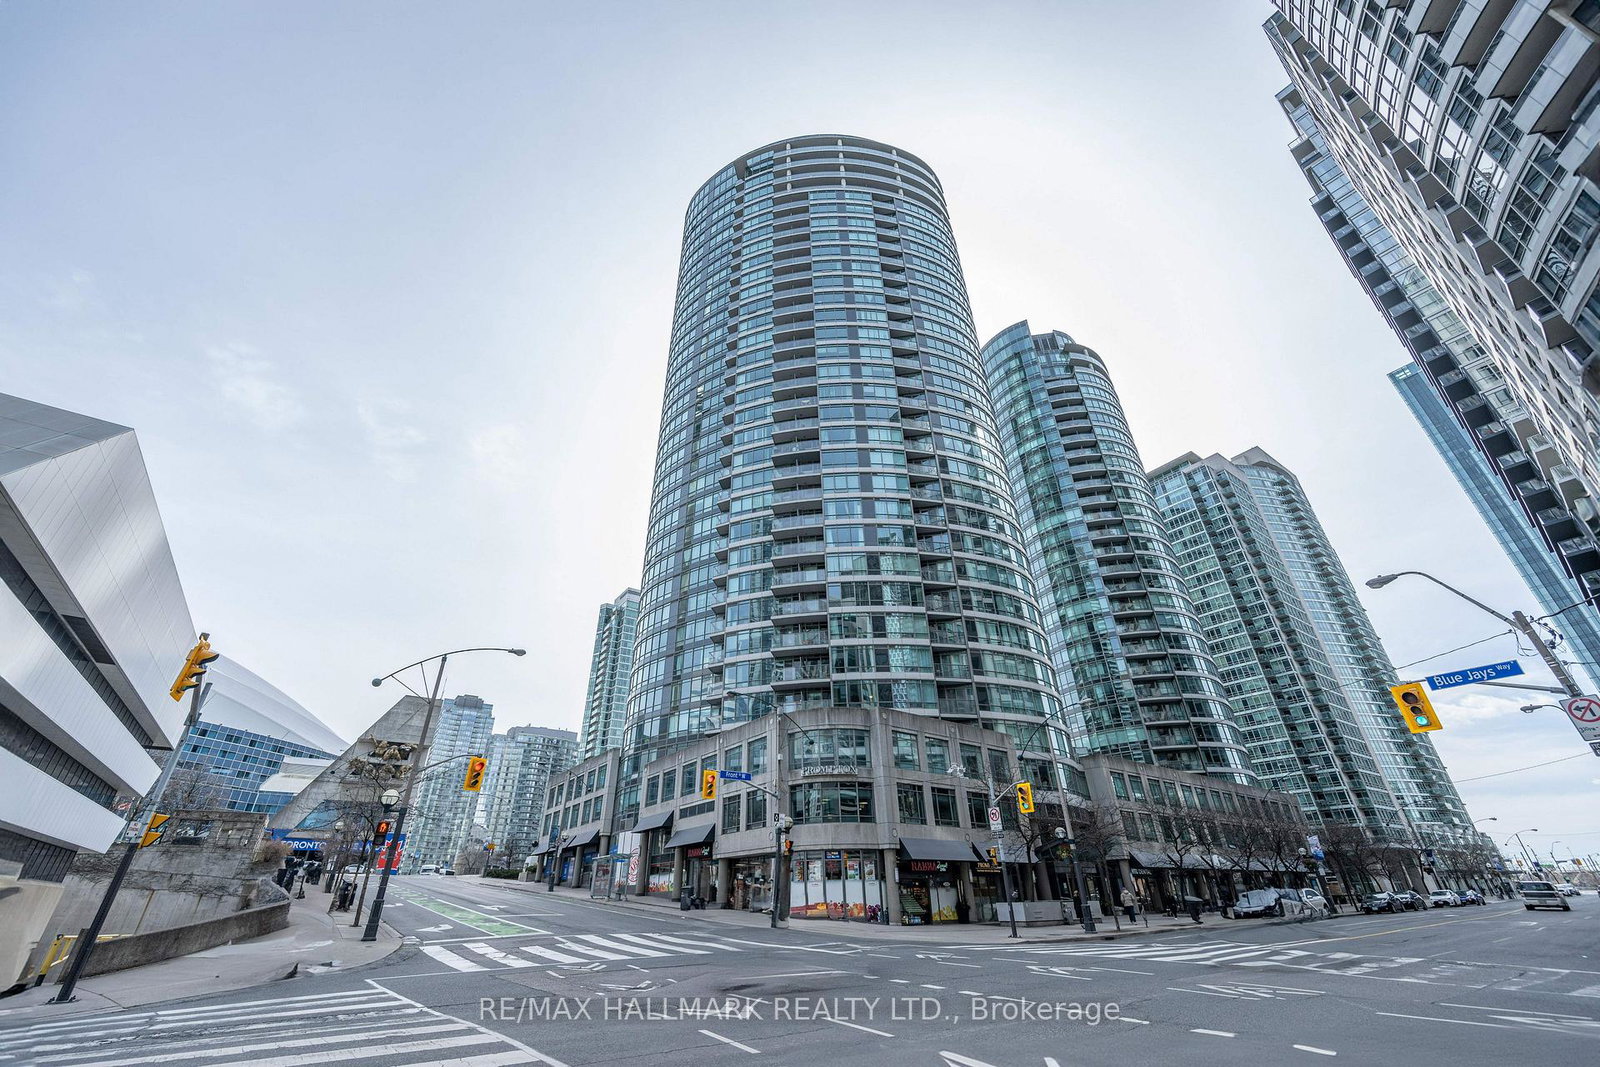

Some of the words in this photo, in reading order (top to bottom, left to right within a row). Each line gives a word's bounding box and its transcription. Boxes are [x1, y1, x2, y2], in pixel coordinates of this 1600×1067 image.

[1433, 674, 1463, 687] Blue
[1466, 668, 1496, 681] Jays
[1495, 663, 1511, 671] Way
[725, 771, 739, 779] Front
